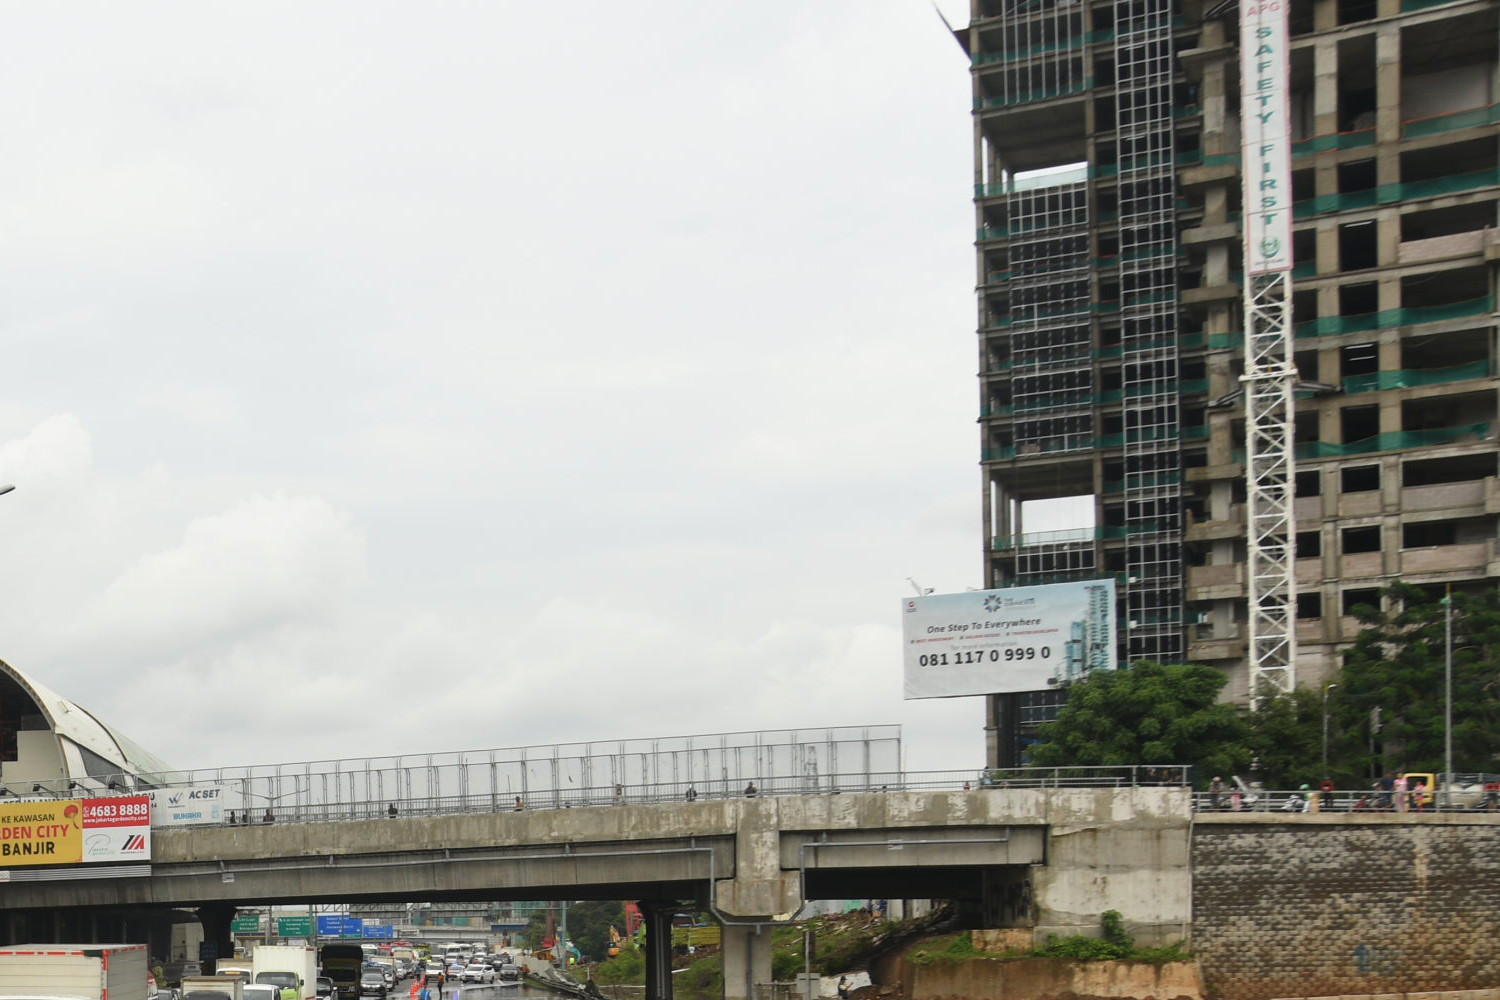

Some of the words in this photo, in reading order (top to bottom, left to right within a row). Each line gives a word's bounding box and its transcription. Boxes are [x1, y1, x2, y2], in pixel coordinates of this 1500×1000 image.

[1246, 1, 1280, 17] APG
[1254, 26, 1273, 124] SAFETY
[1259, 144, 1278, 225] FIRST
[927, 625, 945, 634] One
[948, 624, 969, 632] Step
[972, 622, 982, 630] To
[984, 618, 1041, 629] Everywhere
[919, 653, 948, 667] 081
[955, 651, 984, 665] 117
[990, 649, 999, 662] 0
[1005, 648, 1035, 661] 999
[1041, 646, 1051, 659] 0
[1, 815, 12, 823] KE
[13, 813, 55, 823] KAWASAN
[90, 805, 117, 817] 4683
[120, 803, 148, 816] 8888
[37, 824, 70, 838] CITY
[2, 841, 55, 856] BANJIR
